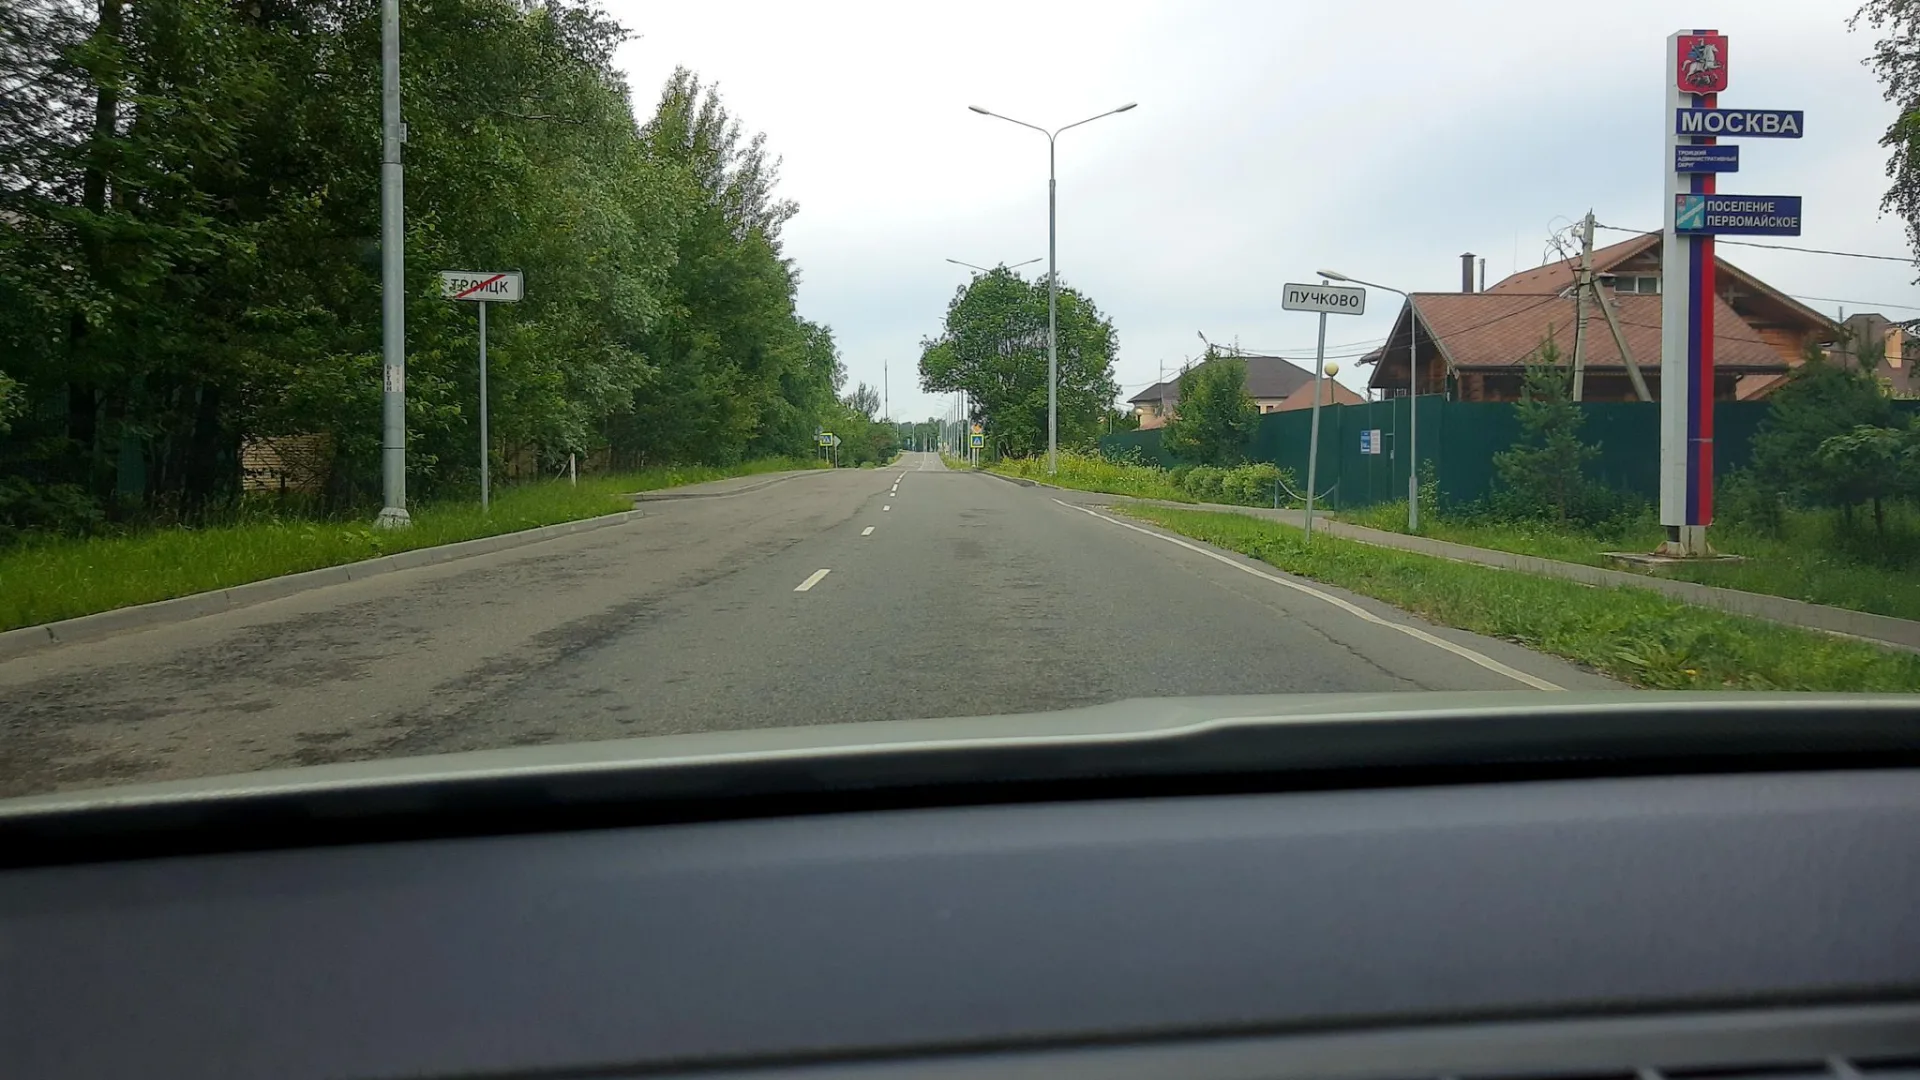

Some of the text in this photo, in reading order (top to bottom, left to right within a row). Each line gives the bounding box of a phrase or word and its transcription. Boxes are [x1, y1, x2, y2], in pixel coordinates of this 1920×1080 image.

[1681, 111, 1799, 134] МОСКВА
[1706, 200, 1775, 213] ПОСЕЛЕНИЕ
[1706, 214, 1799, 228] ПЕРВОМАЙСКОЕ
[449, 278, 509, 295] ТРОИЦК
[1289, 290, 1359, 308] ПУЧКОВО
